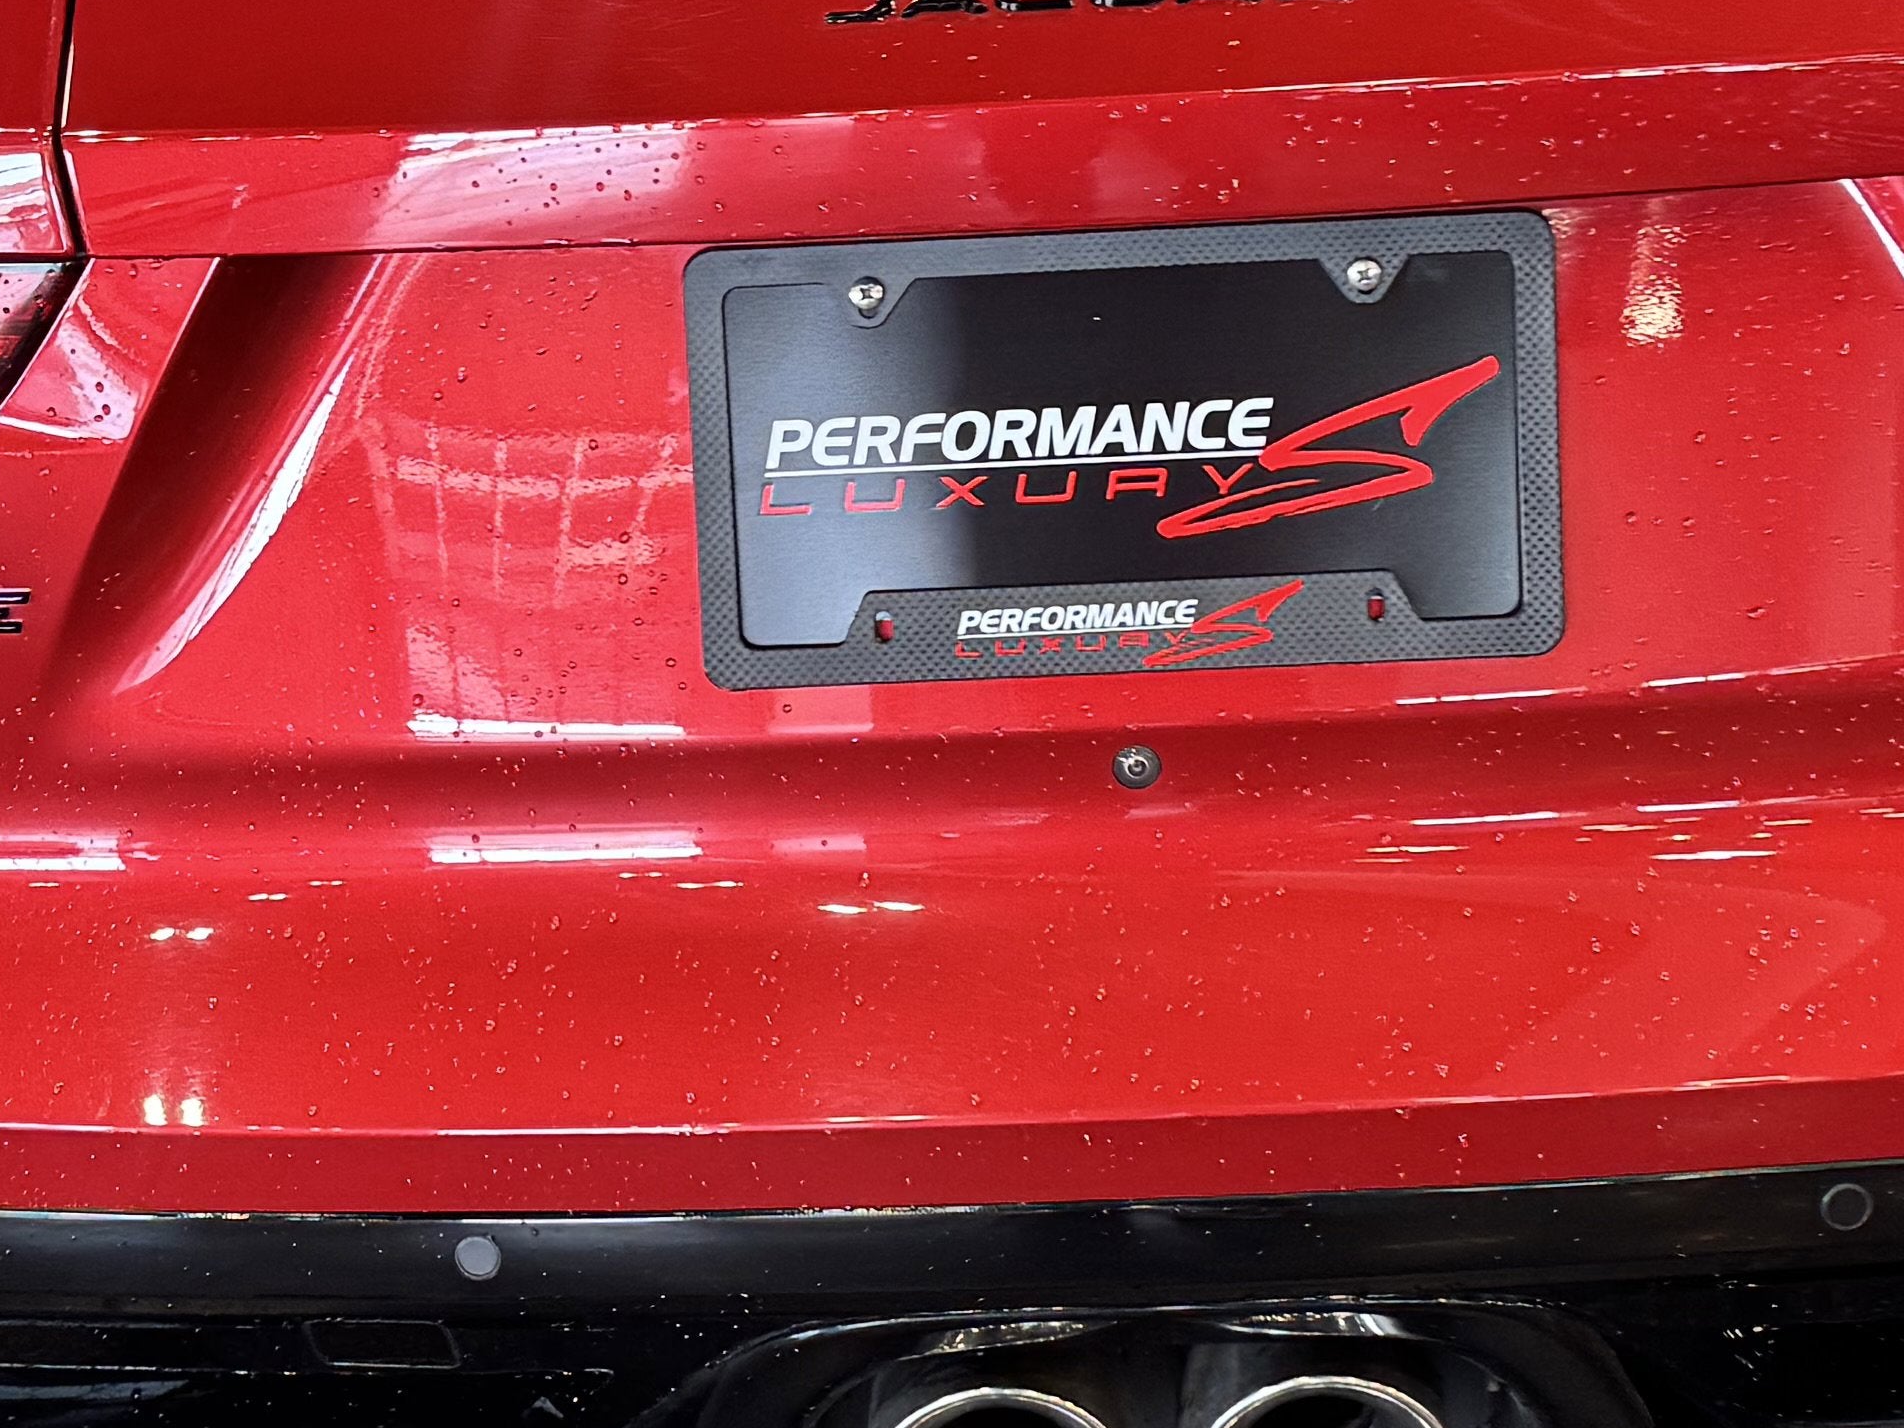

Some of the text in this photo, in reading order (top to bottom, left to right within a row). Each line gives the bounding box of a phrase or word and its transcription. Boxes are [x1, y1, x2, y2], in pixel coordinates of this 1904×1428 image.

[764, 396, 1274, 470] PERFORMANCE
[759, 462, 1254, 517] LUXURY
[956, 598, 1199, 635] PERFORMANCE
[954, 632, 1193, 659] LUXURY
